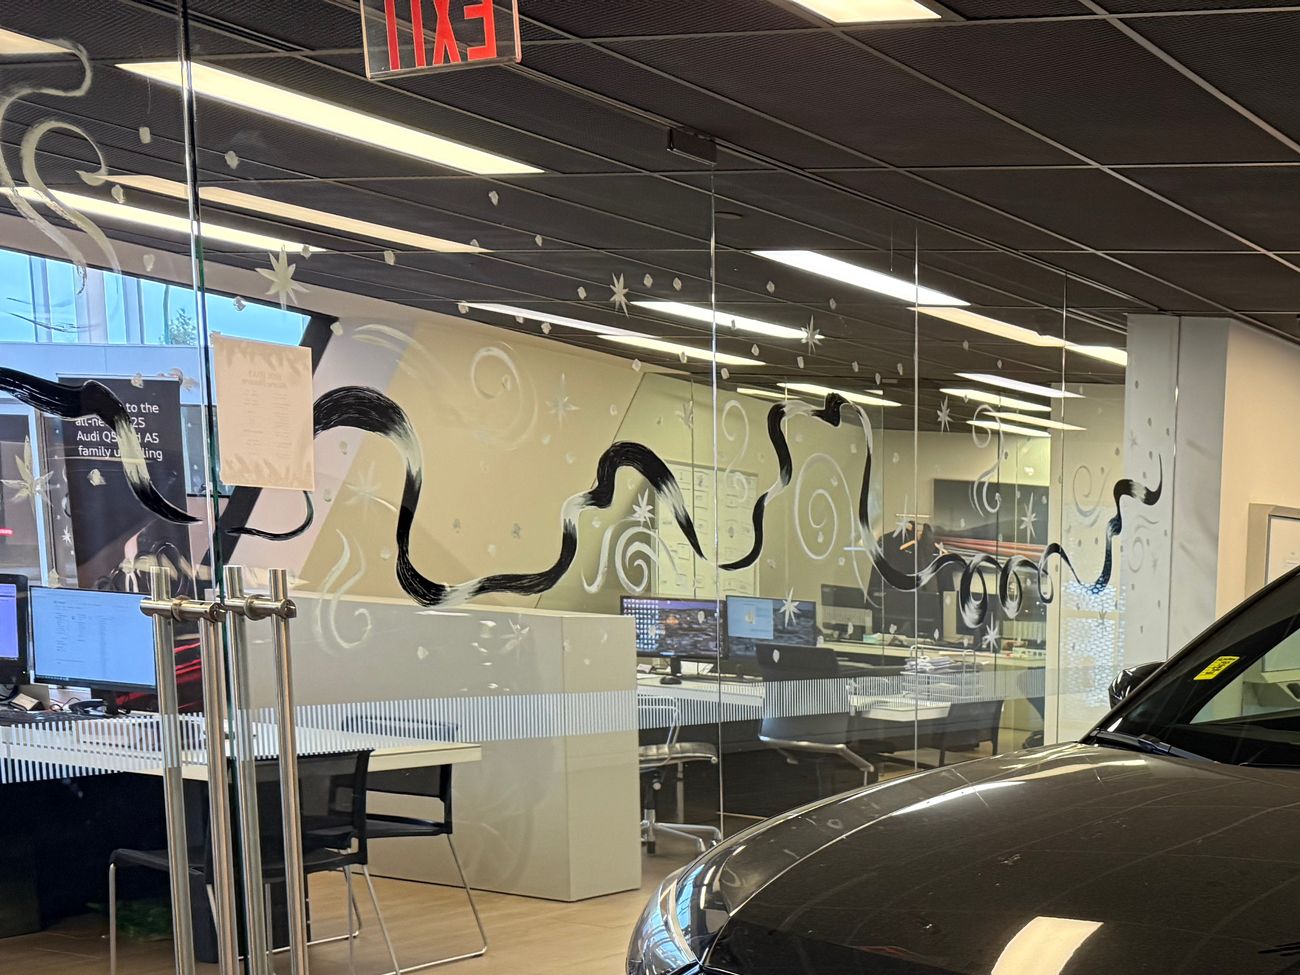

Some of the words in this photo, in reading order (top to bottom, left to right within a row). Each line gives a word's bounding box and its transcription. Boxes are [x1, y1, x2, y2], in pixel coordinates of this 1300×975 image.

[126, 403, 138, 413] to
[141, 402, 159, 413] the
[76, 417, 105, 427] all-ne
[77, 430, 100, 442] Audi
[145, 433, 160, 443] A5
[78, 446, 111, 459] family
